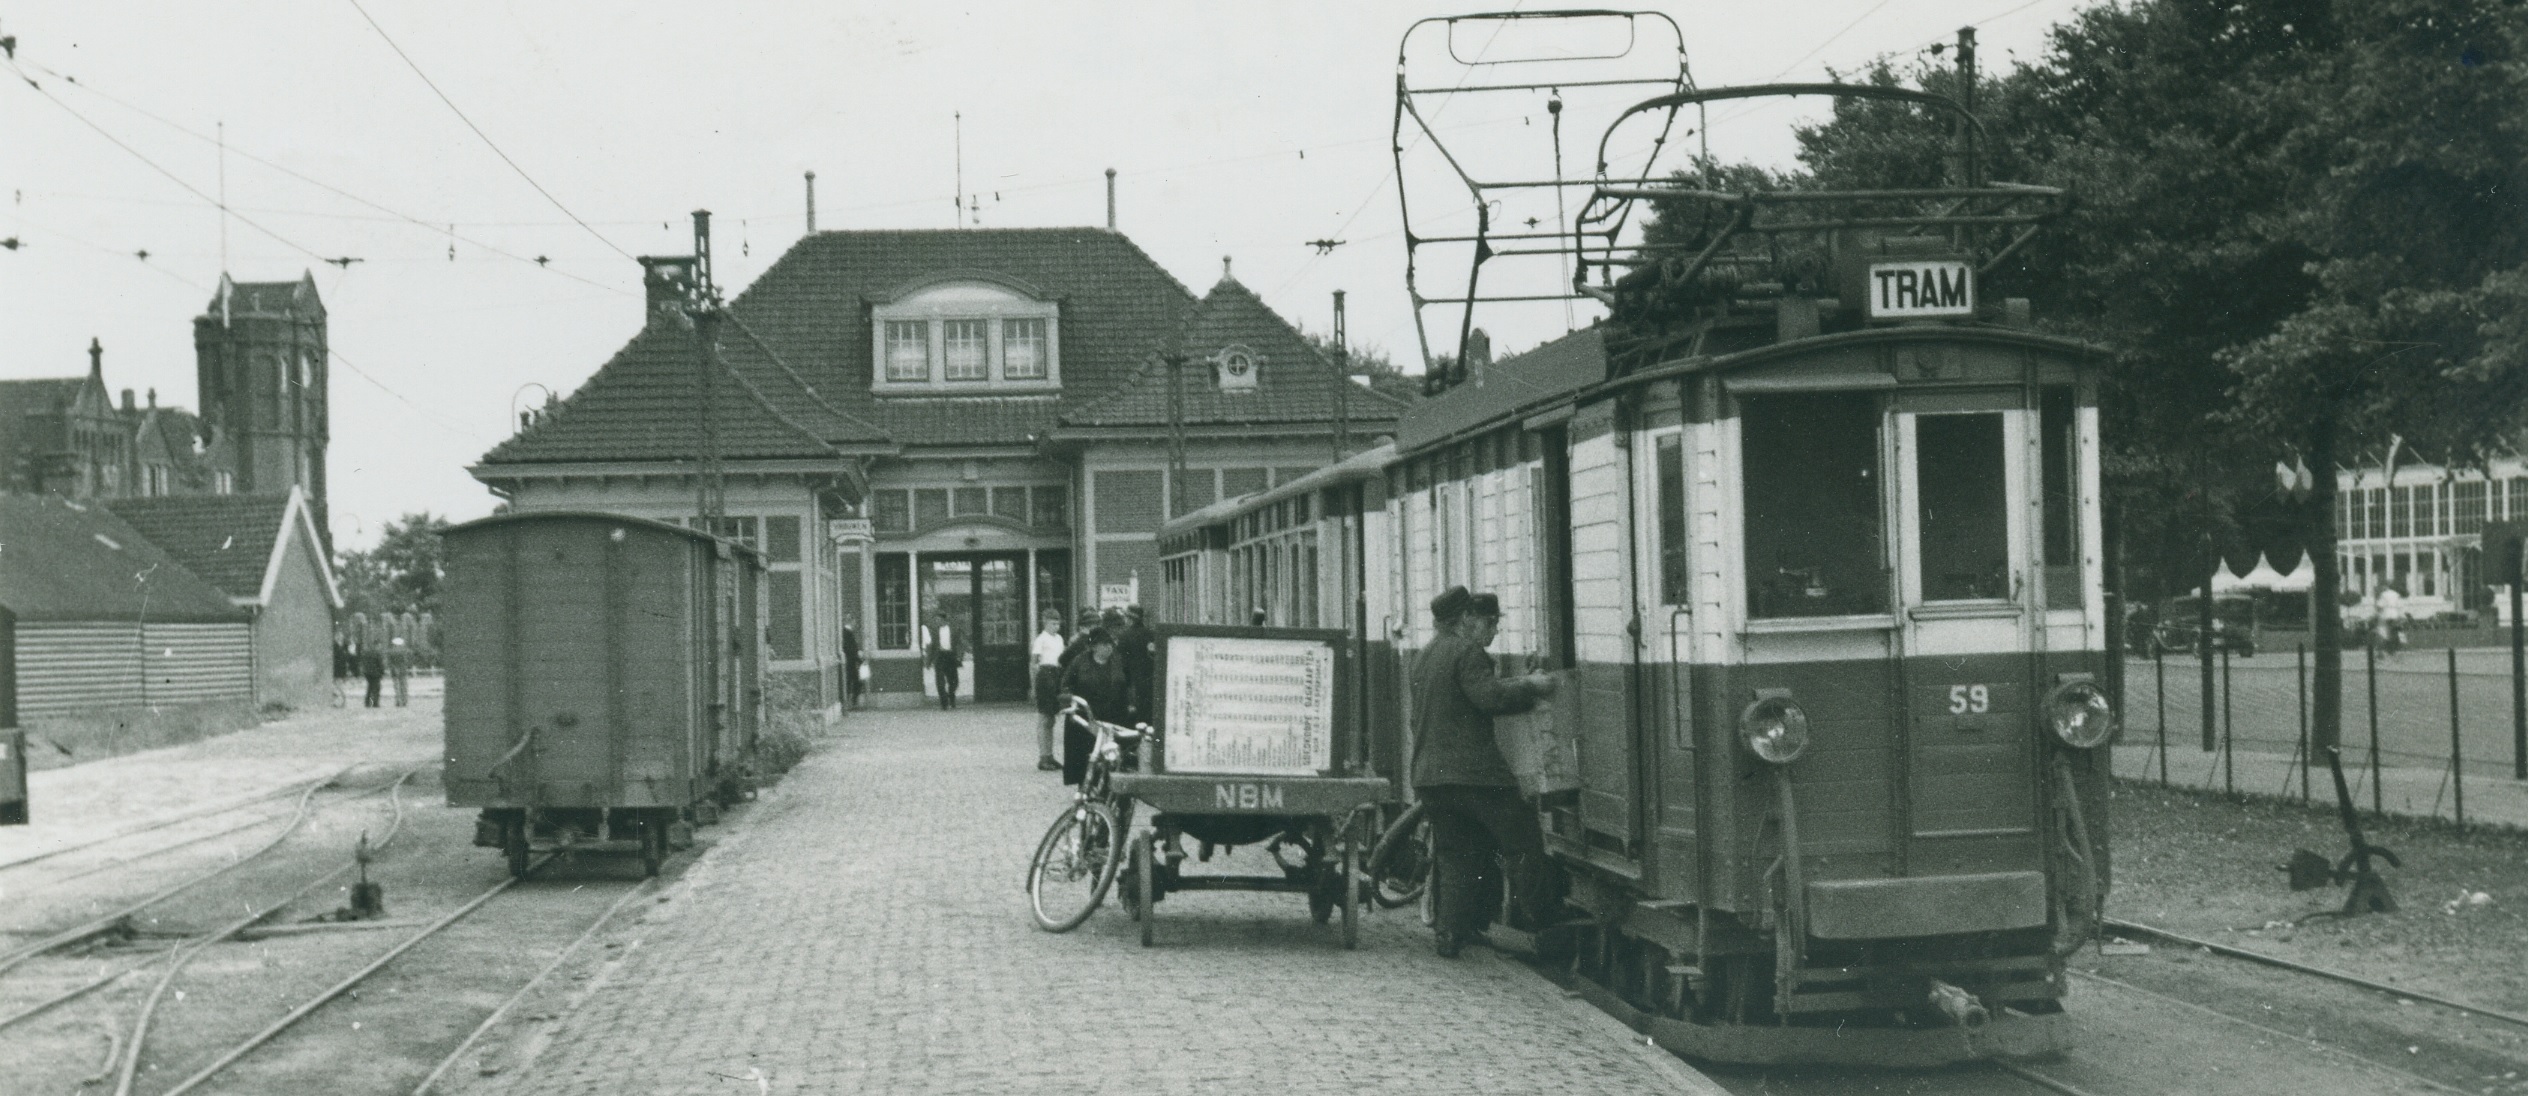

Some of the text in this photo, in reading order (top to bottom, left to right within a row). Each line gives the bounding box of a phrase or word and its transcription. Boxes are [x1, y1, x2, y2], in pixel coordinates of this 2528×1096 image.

[1875, 266, 1967, 308] TRAM
[1105, 586, 1129, 595] TAXI
[1949, 683, 1989, 714] 59
[1216, 784, 1284, 808] NBM
